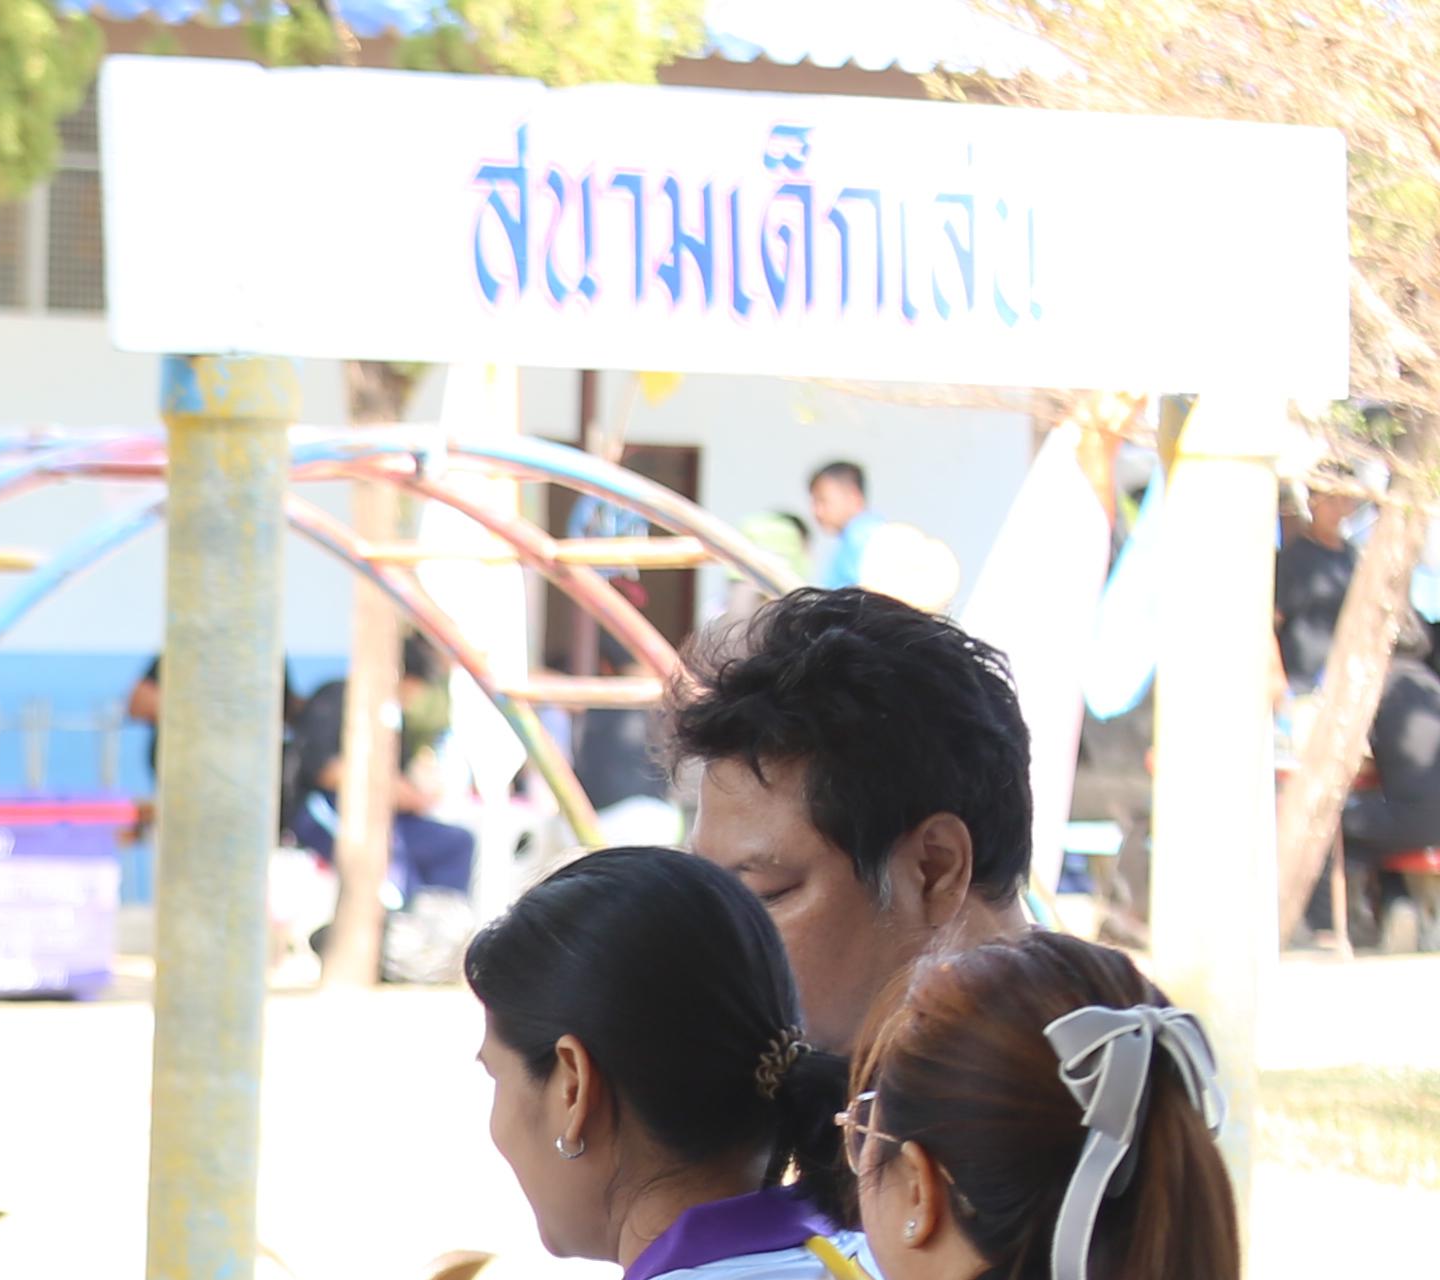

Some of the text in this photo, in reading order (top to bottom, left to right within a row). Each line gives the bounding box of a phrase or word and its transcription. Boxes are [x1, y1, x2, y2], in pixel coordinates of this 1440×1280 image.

[469, 122, 1046, 327] สนามเด็กเล่น
